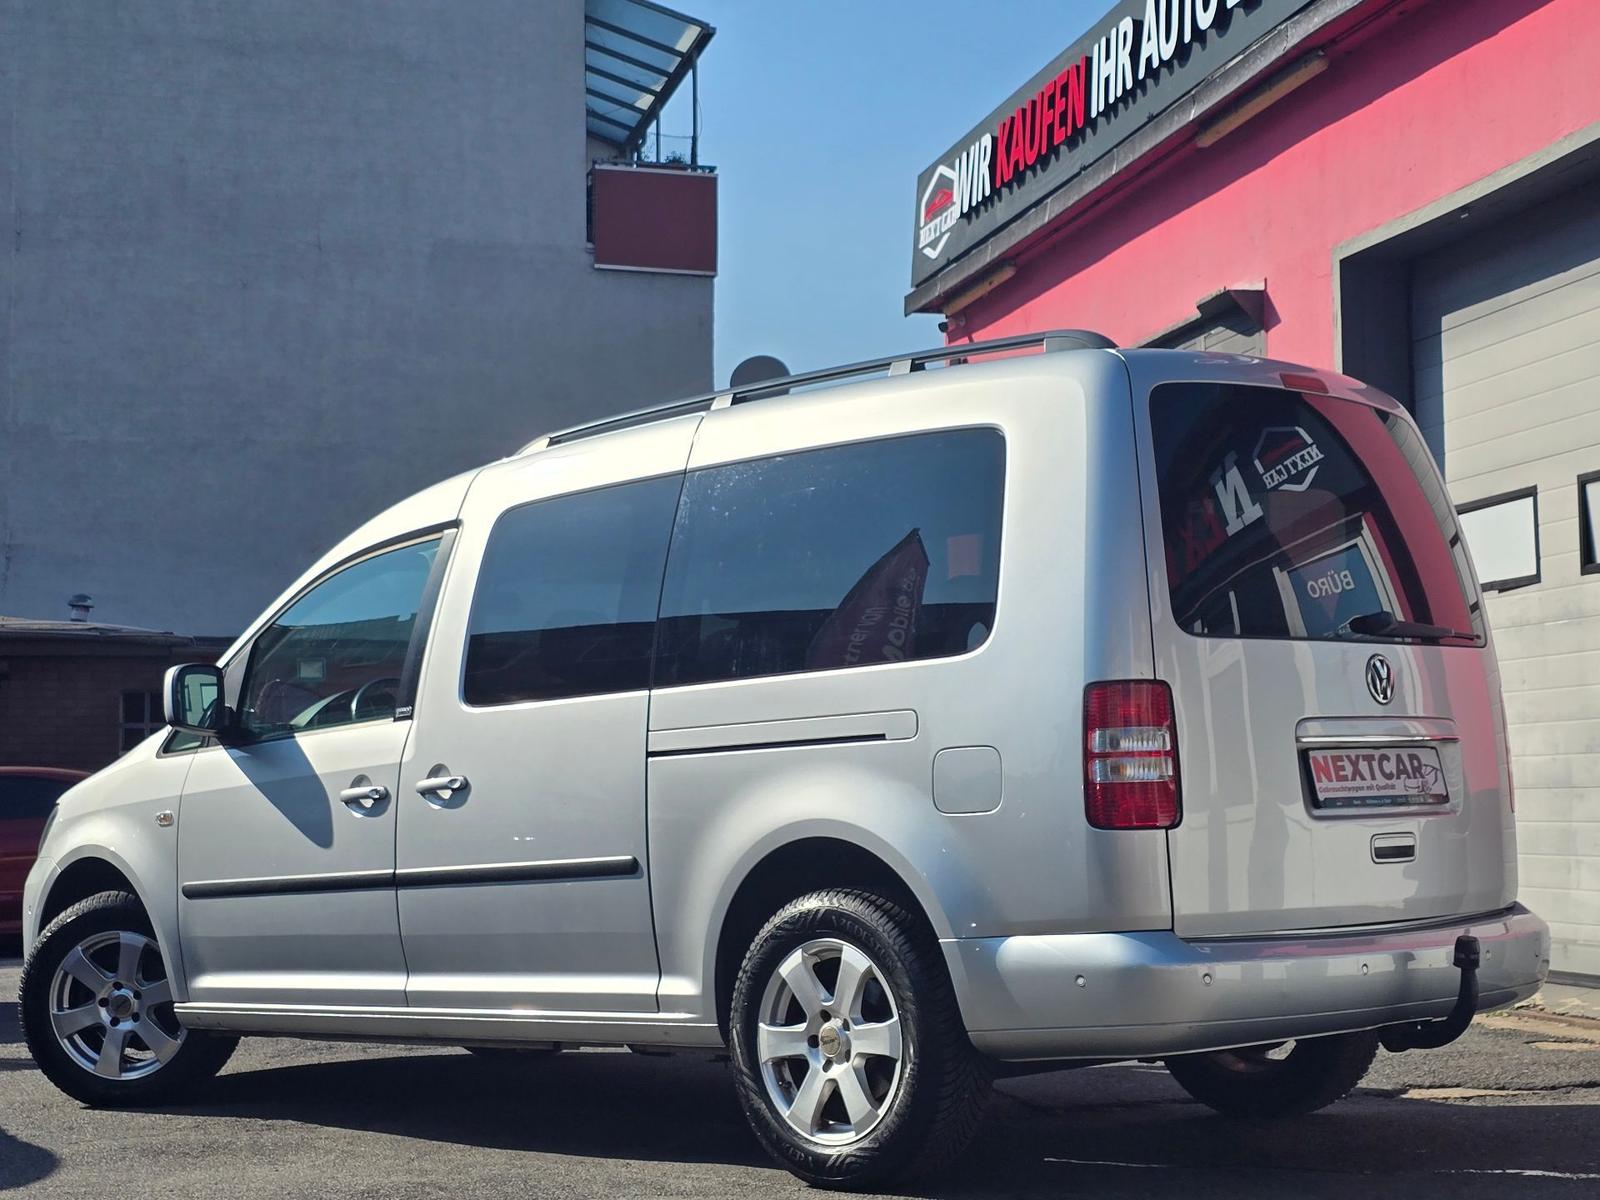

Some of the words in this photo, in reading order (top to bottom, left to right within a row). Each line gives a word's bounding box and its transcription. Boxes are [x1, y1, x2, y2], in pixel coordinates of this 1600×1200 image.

[954, 132, 992, 219] WIR
[996, 55, 1087, 189] KAUFEN
[1090, 16, 1134, 119] IHR
[1311, 753, 1425, 783] NEXTCAR
